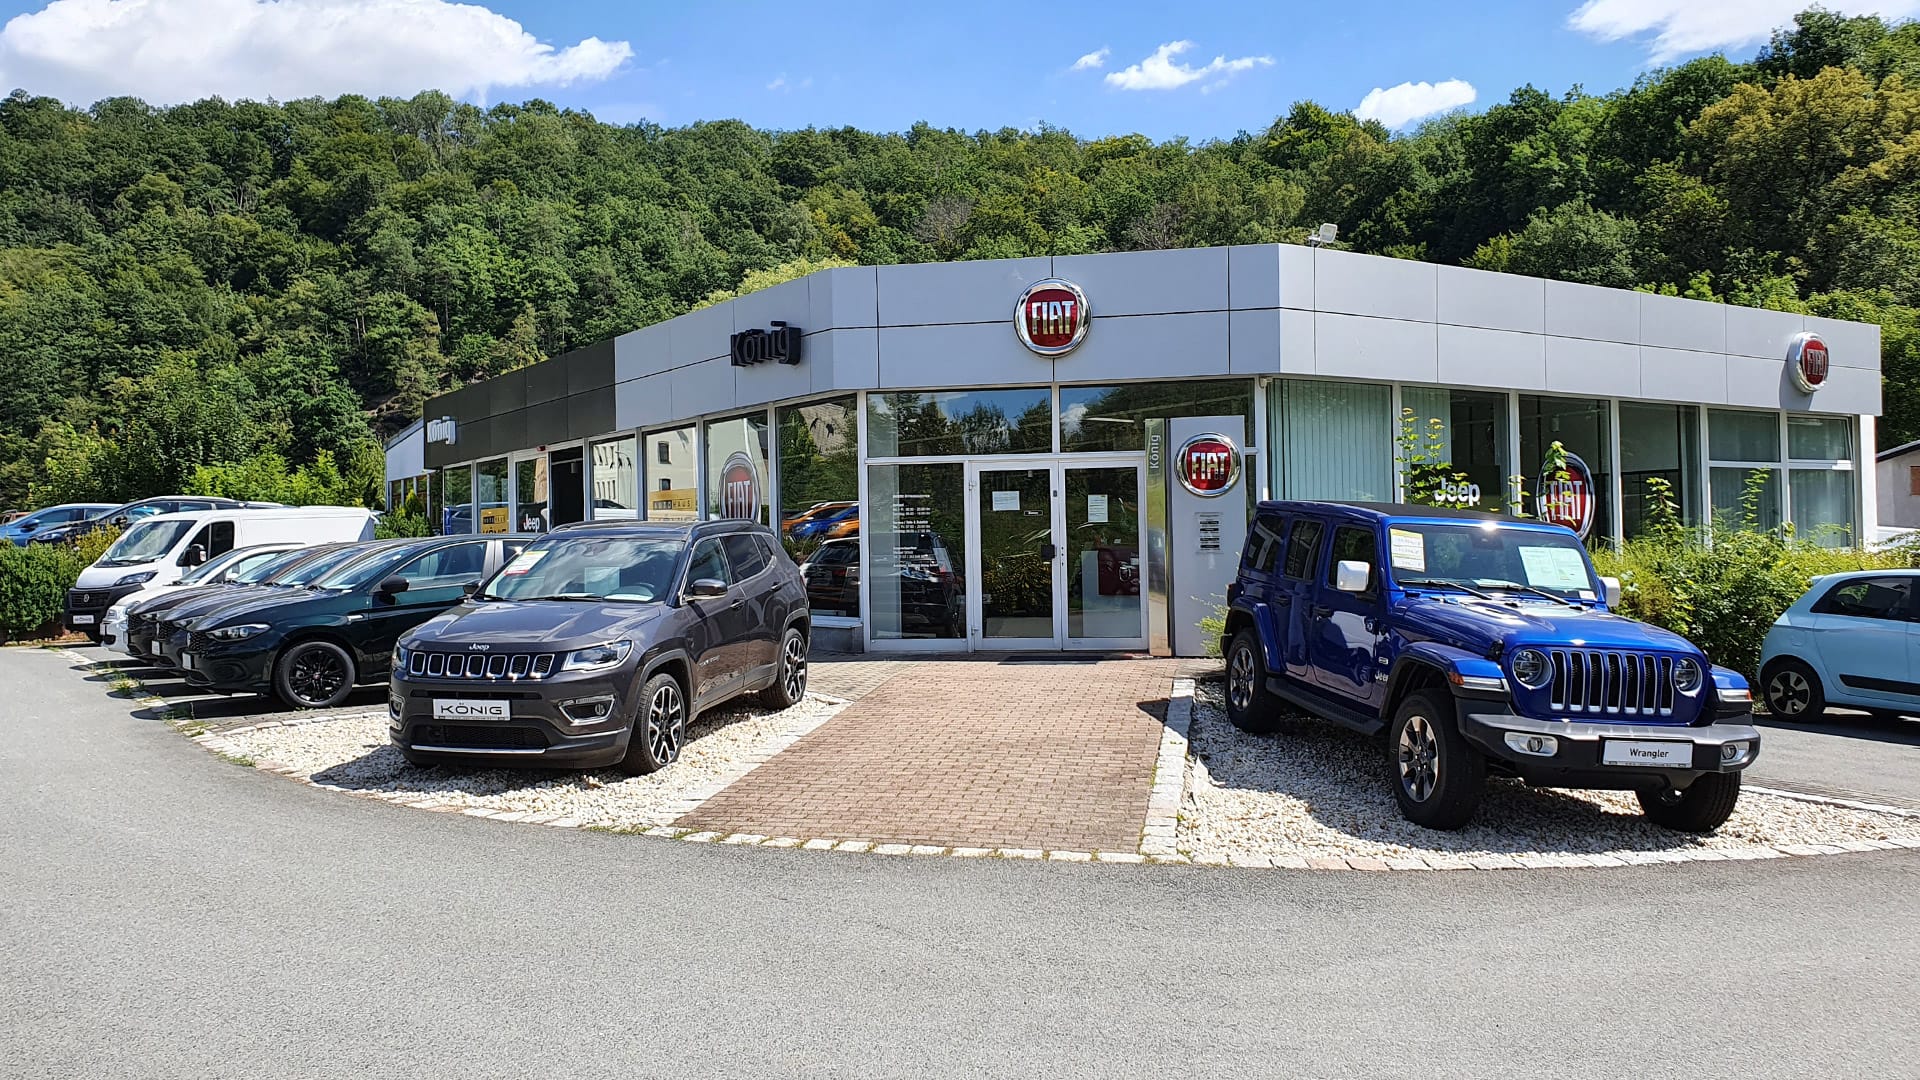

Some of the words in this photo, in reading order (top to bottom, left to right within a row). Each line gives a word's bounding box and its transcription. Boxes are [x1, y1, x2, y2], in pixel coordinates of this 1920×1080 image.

[1032, 301, 1075, 336] FIAT
[731, 320, 802, 368] König
[1806, 348, 1826, 376] FIAT
[1149, 434, 1161, 469] König
[1191, 452, 1229, 480] FIAT
[727, 480, 752, 519] FIAT
[1433, 477, 1481, 507] Jeep
[1549, 480, 1583, 521] FIAT
[523, 513, 540, 533] Jeep
[468, 642, 490, 652] Jeep
[440, 702, 503, 715] KÖNIG
[1629, 747, 1670, 760] Wrangler
